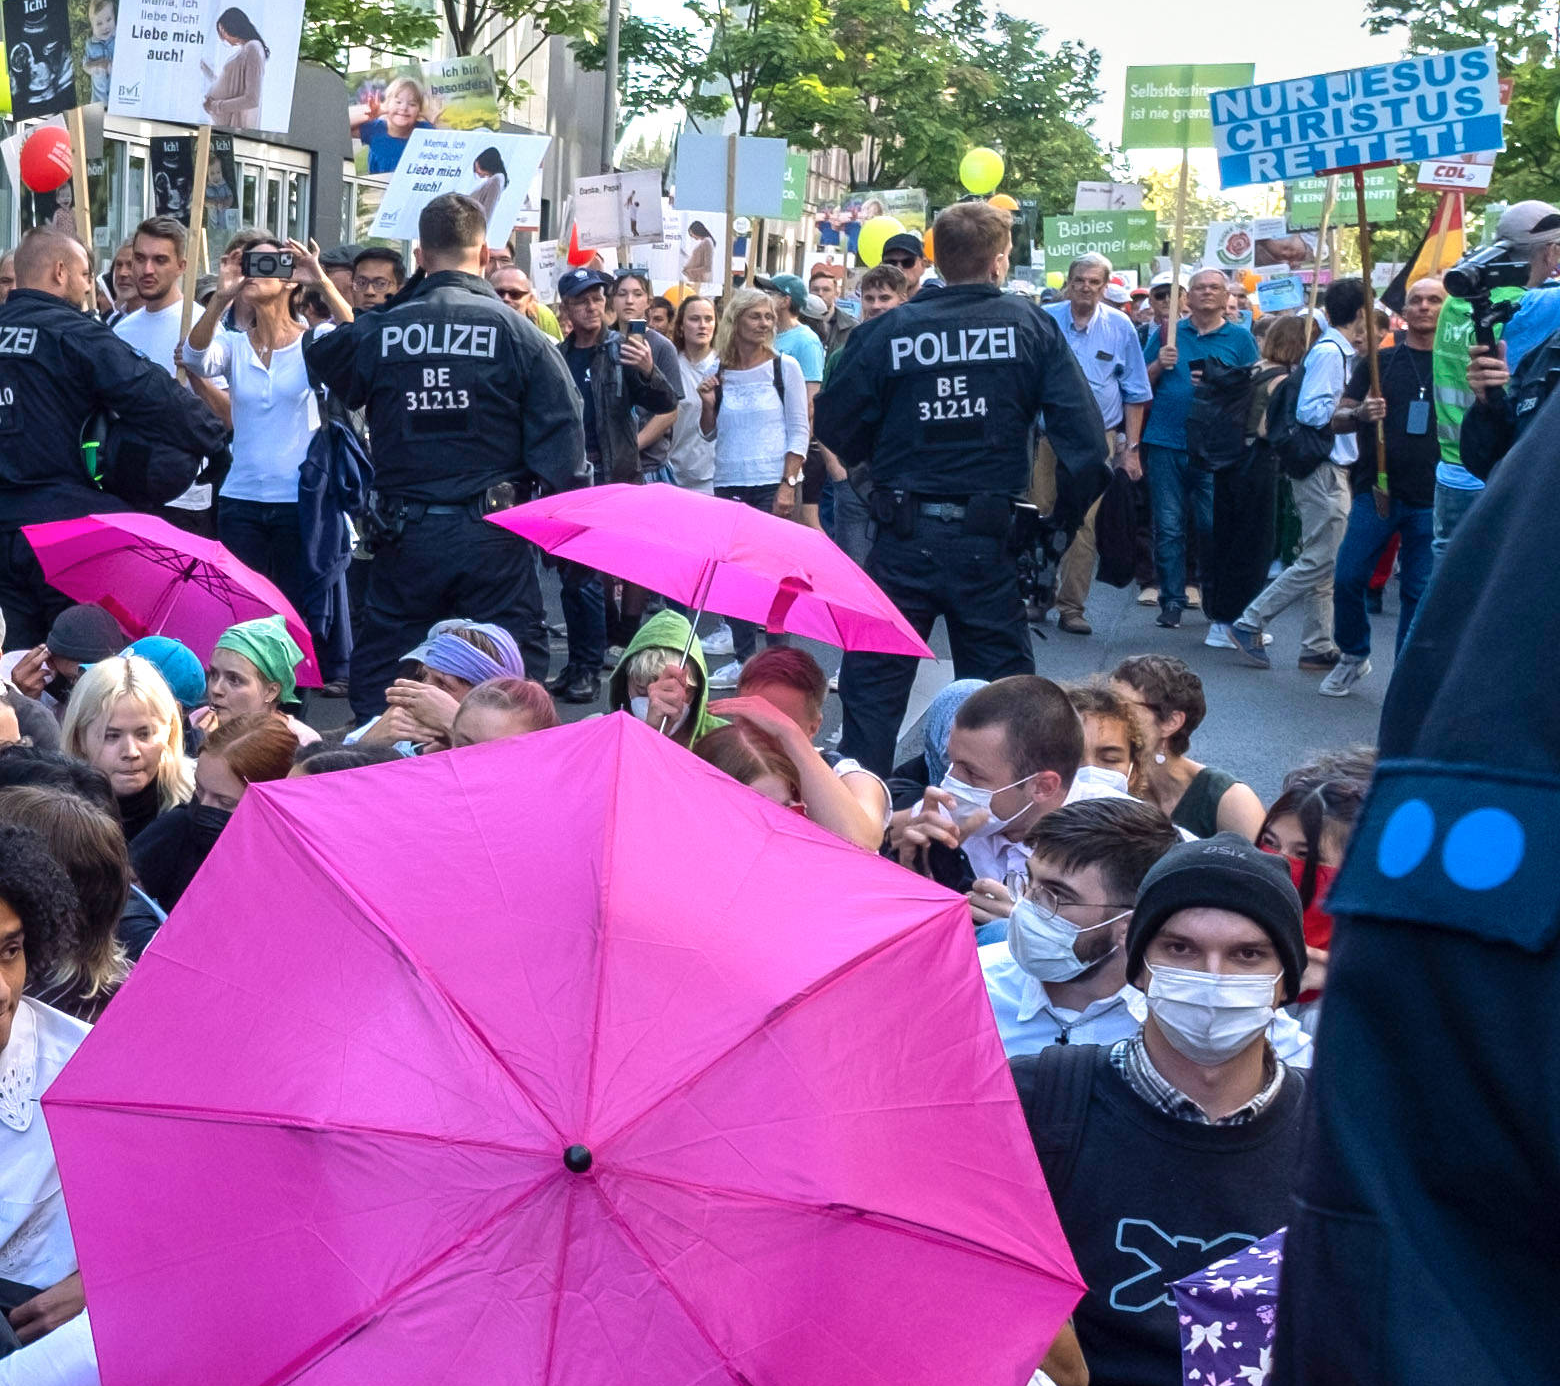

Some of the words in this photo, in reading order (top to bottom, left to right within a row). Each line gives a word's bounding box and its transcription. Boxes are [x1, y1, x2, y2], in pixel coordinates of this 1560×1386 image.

[140, 9, 168, 21] liebe
[170, 12, 200, 25] Dich!
[131, 25, 169, 42] Liebe
[172, 29, 205, 45] mich
[147, 48, 184, 63] auch!
[442, 65, 459, 79] Ich
[462, 63, 480, 76] bin
[1214, 79, 1315, 124] NUR
[1328, 51, 1489, 103] JESUS
[1131, 106, 1145, 120] ist
[1149, 105, 1169, 119] nie
[1226, 85, 1484, 153] CHRISTUS
[163, 141, 179, 153] Ich!
[1248, 121, 1465, 182] RETTET!
[406, 163, 435, 175] Liebe
[436, 165, 462, 178] mich
[1434, 165, 1464, 179] CDL
[412, 180, 443, 192] auch!
[1056, 220, 1114, 238] Babies
[1047, 239, 1126, 256] welcome!
[382, 324, 497, 358] POLIZEI
[891, 327, 1016, 370] POLIZEI
[423, 368, 450, 388] BE
[937, 376, 968, 397] BE
[406, 390, 470, 411] 31213
[918, 397, 988, 421] 31214
